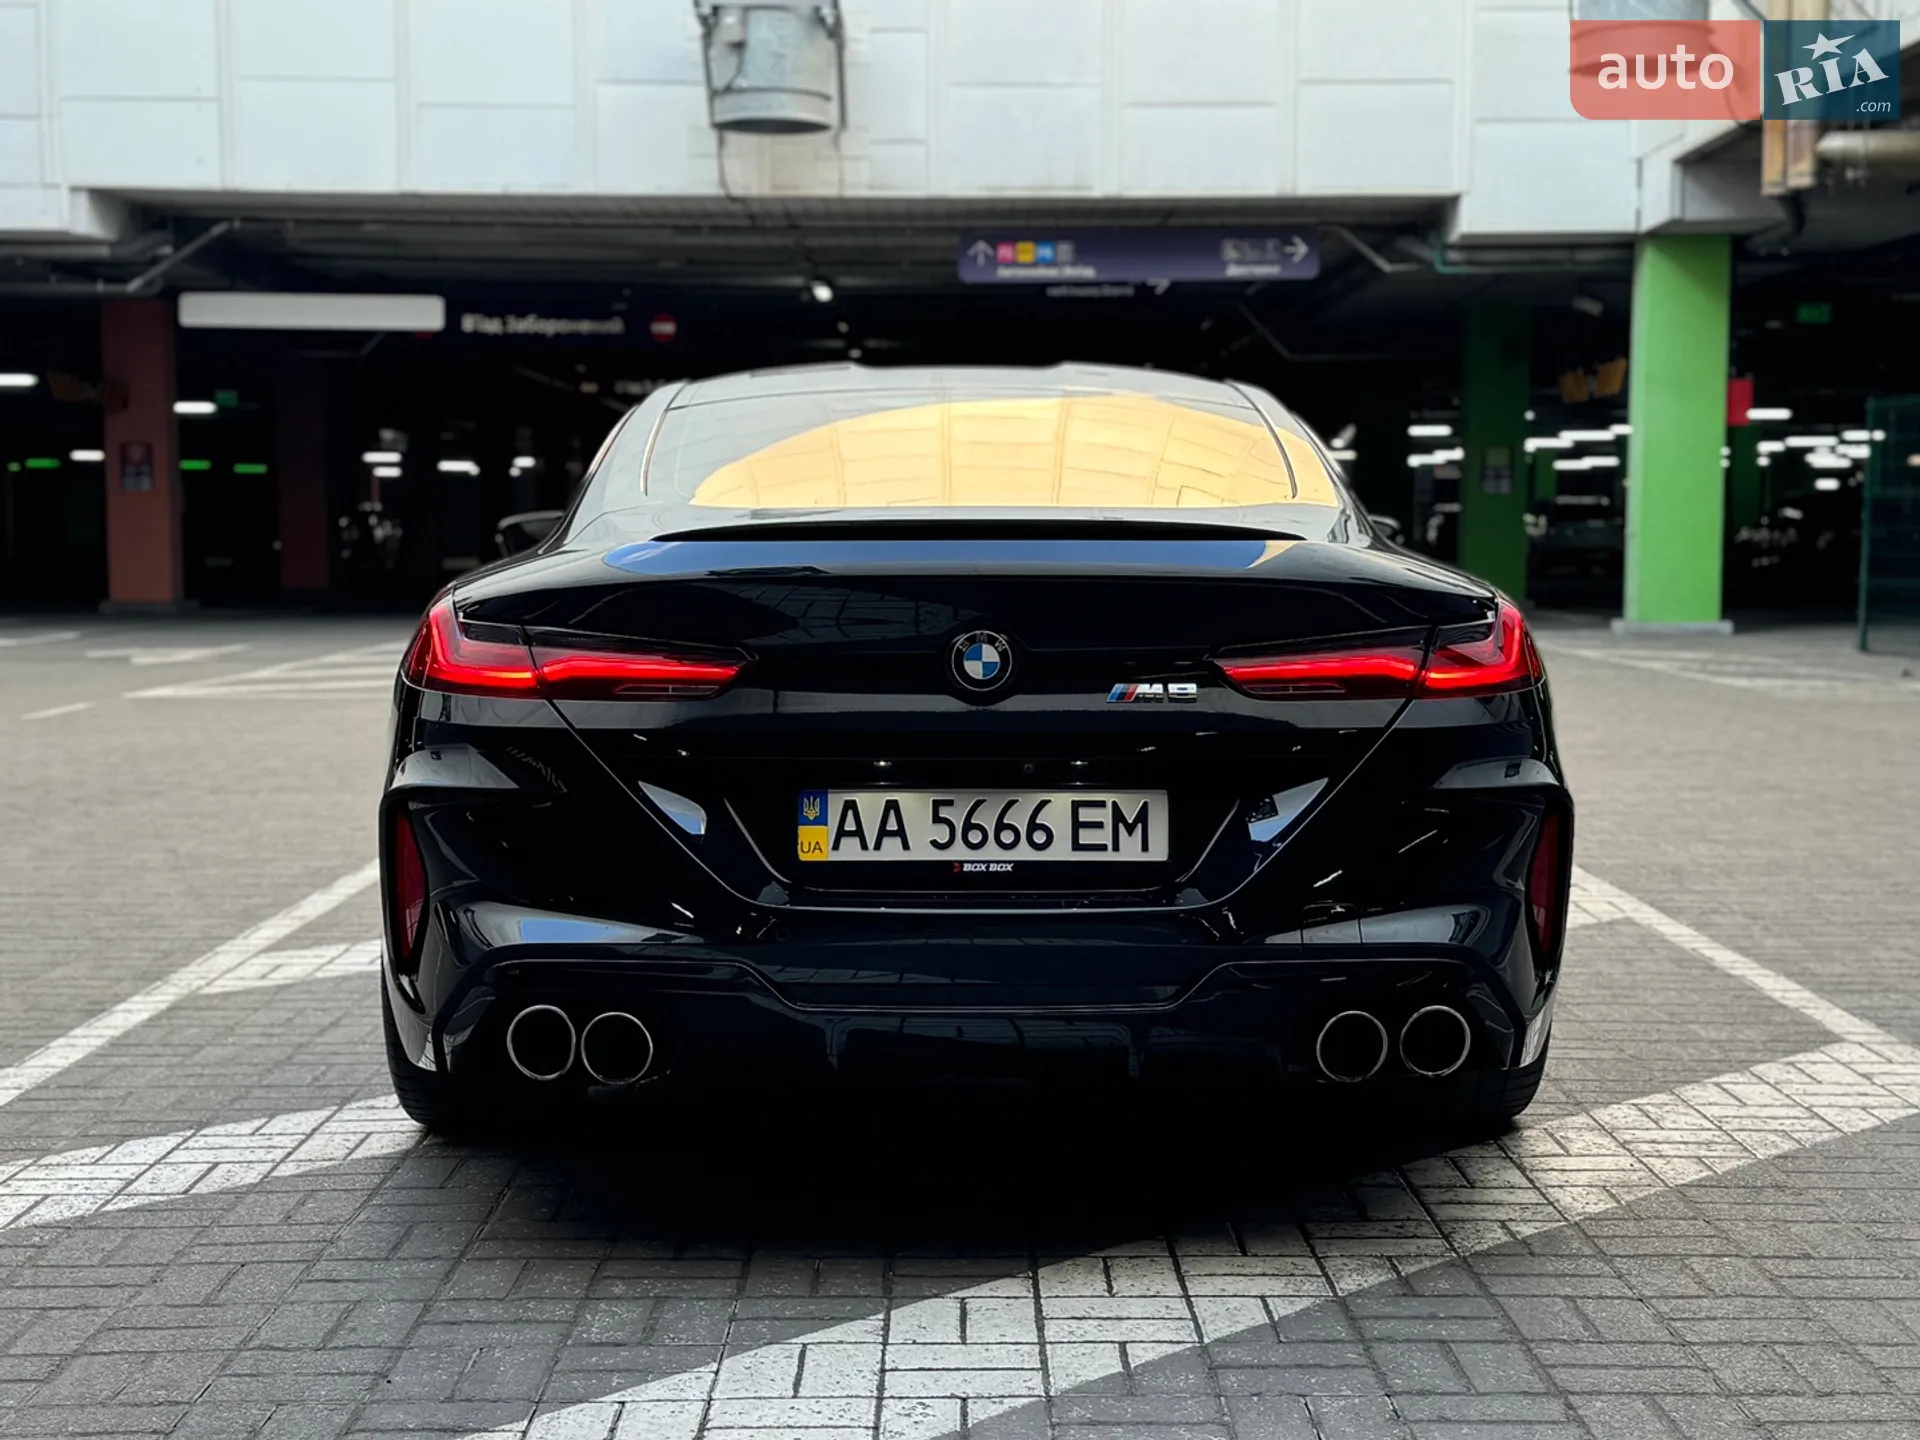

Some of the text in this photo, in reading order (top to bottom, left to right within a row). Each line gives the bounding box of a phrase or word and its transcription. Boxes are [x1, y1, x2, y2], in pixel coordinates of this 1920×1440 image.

[958, 632, 1007, 652] BMW
[831, 798, 1150, 852] AA 5666 EM
[800, 840, 823, 855] UA
[963, 862, 1014, 872] BOX BOX
